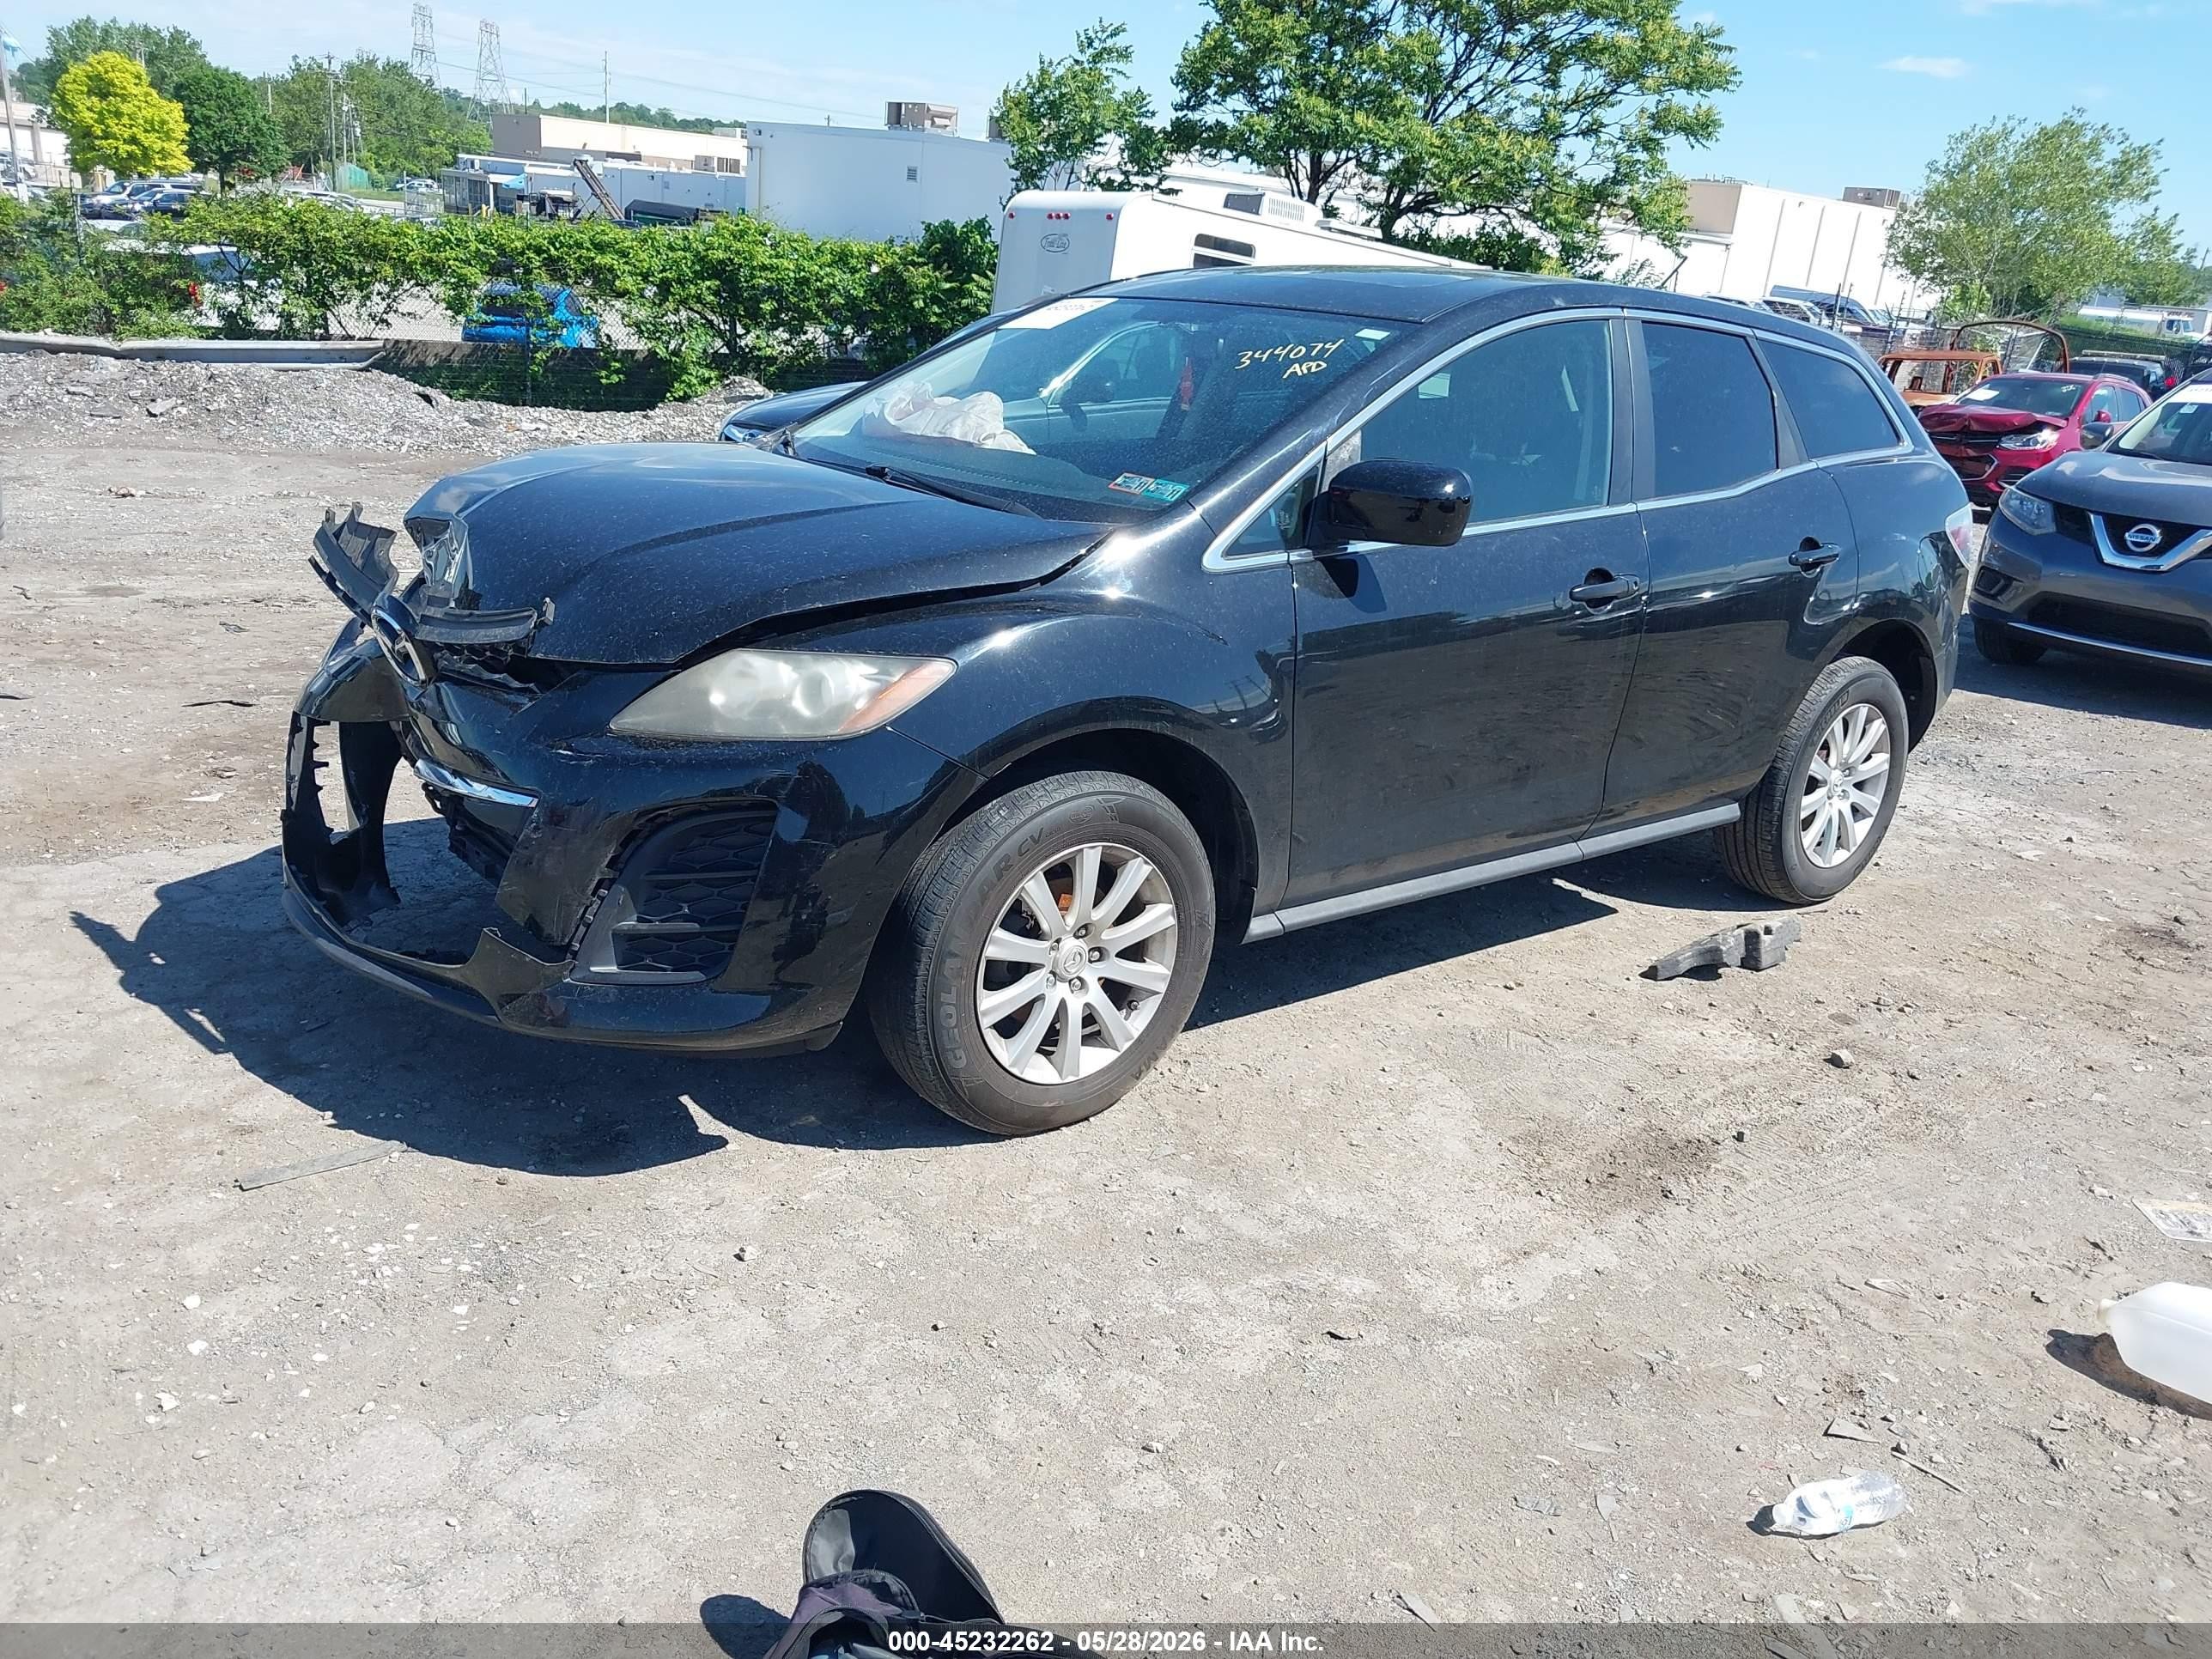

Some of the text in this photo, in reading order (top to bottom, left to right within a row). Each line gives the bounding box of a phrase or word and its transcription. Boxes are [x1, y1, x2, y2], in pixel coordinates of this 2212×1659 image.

[1234, 338, 1345, 369] 344074
[2127, 532, 2156, 543] NISSAN
[940, 827, 1043, 1068] GEOLANAR CV
